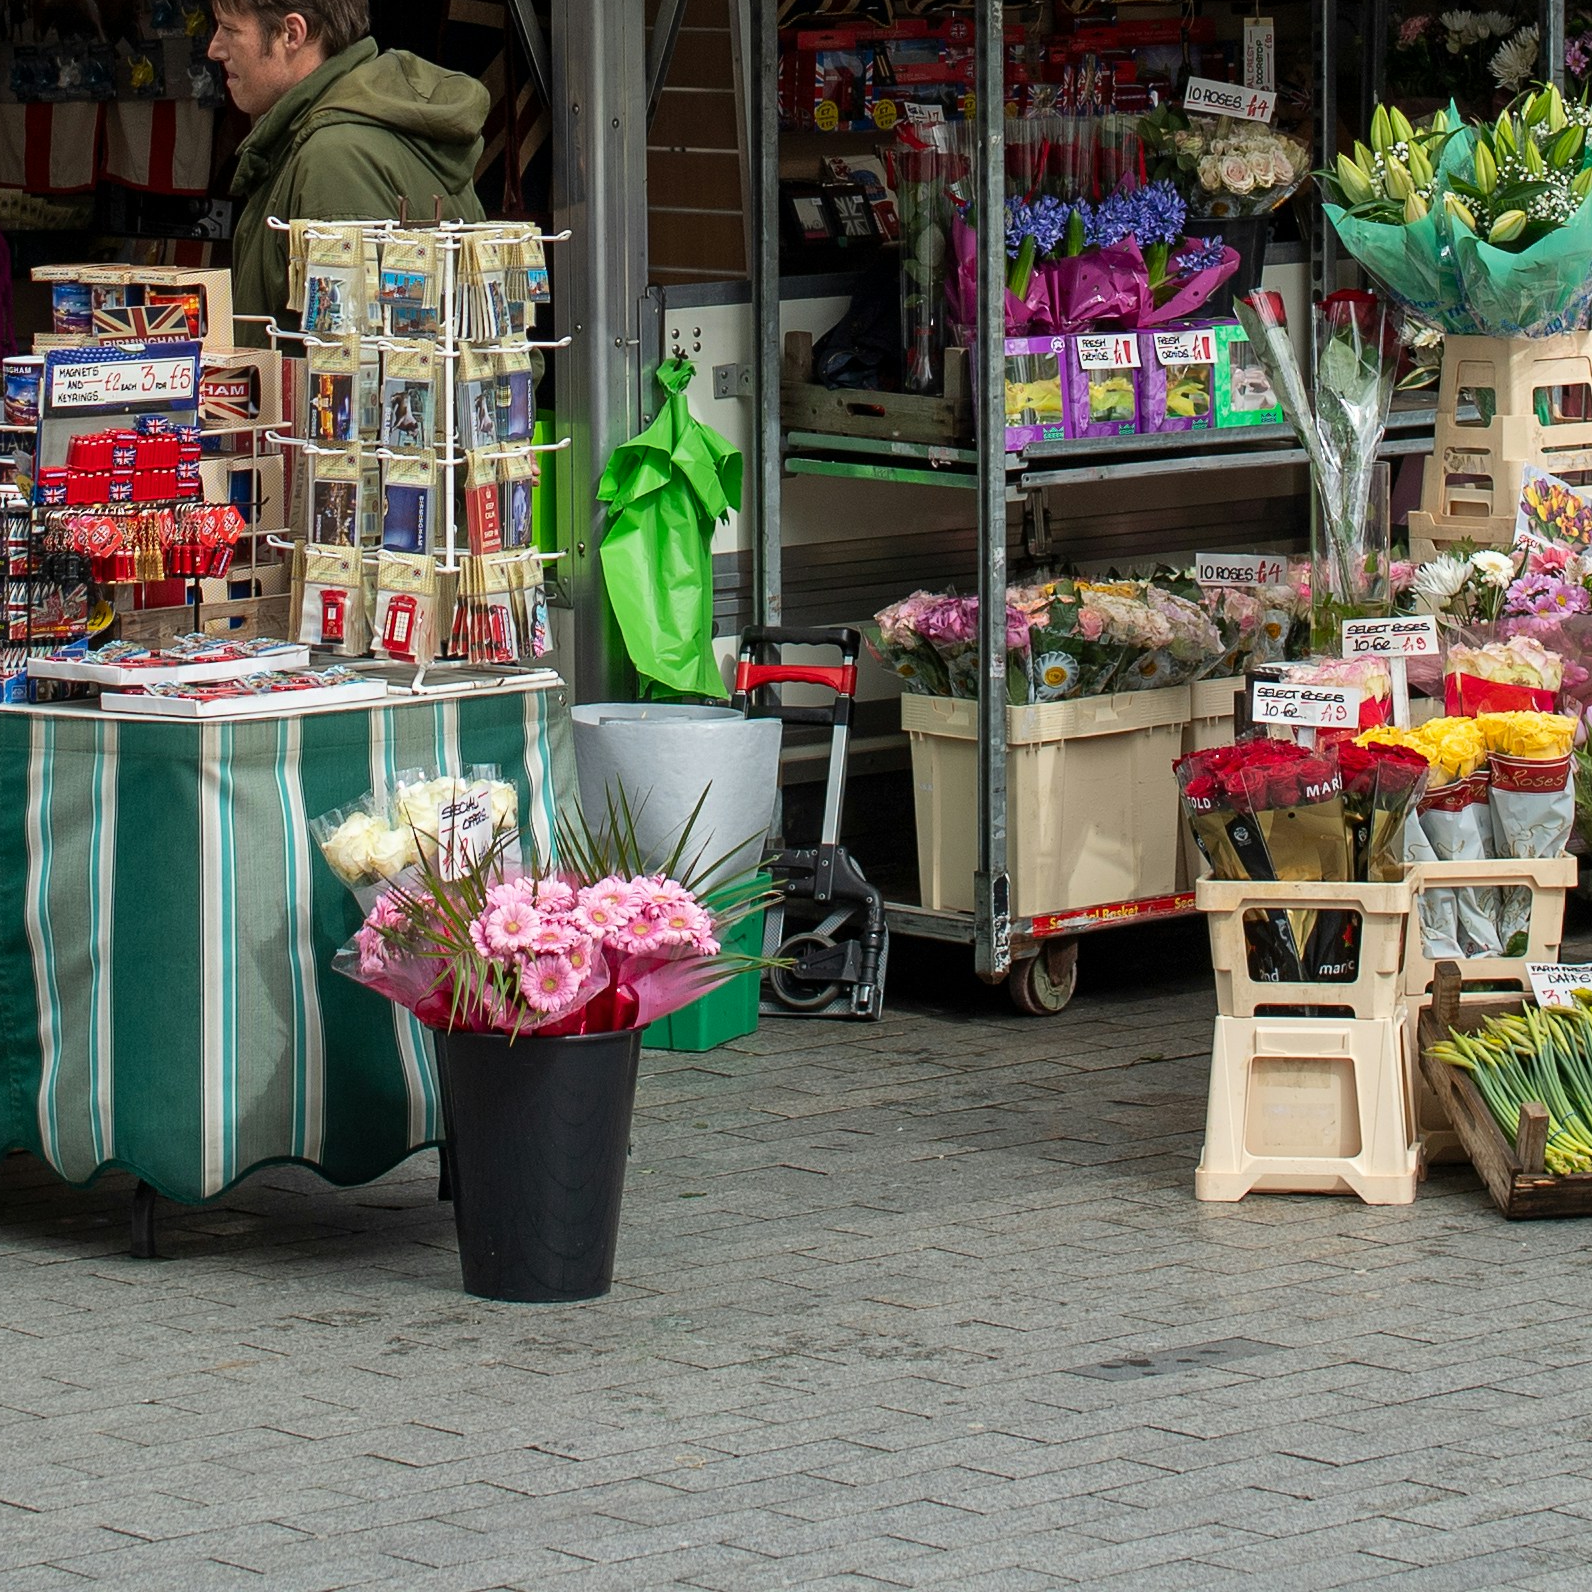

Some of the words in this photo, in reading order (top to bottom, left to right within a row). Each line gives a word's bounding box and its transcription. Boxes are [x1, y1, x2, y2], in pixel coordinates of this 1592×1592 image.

[1188, 85, 1202, 101] 10
[67, 380, 84, 390] AND
[104, 372, 121, 392] £2
[141, 364, 157, 392] 3
[169, 363, 191, 390] £5
[1199, 564, 1215, 580] 10
[1352, 637, 1371, 652] 10
[1262, 702, 1279, 717] 10
[1102, 904, 1140, 920] Basket
